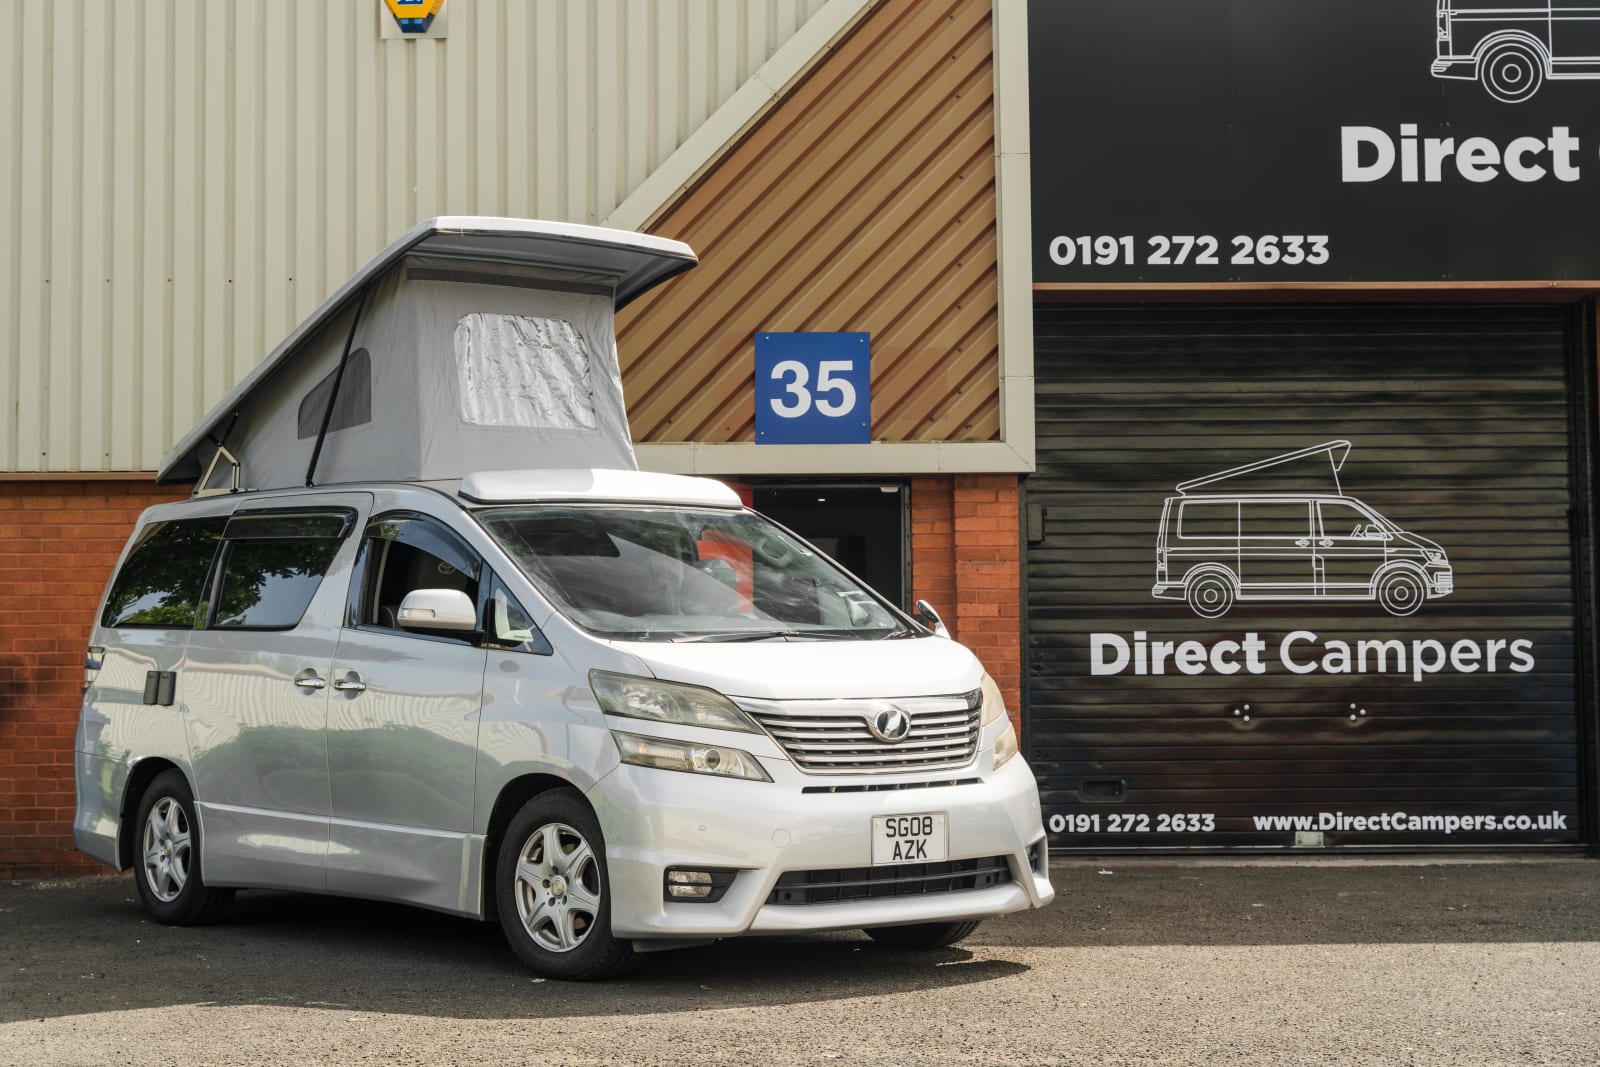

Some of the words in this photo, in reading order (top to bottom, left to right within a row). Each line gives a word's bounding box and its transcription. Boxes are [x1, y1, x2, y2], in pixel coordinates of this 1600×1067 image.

[1340, 123, 1581, 183] Direct
[1049, 235, 1135, 266] 0191
[1147, 235, 1219, 265] 272
[1230, 234, 1330, 266] 2633
[770, 360, 857, 419] 35
[1089, 630, 1266, 676] Direct
[1279, 630, 1535, 682] Campers
[885, 816, 933, 838] SG08
[1049, 814, 1100, 833] 0191
[1107, 813, 1150, 832] 272
[1156, 813, 1216, 832] 2633
[1252, 810, 1567, 835] www.DirectCampers.co.uk
[892, 839, 927, 861] AZK
